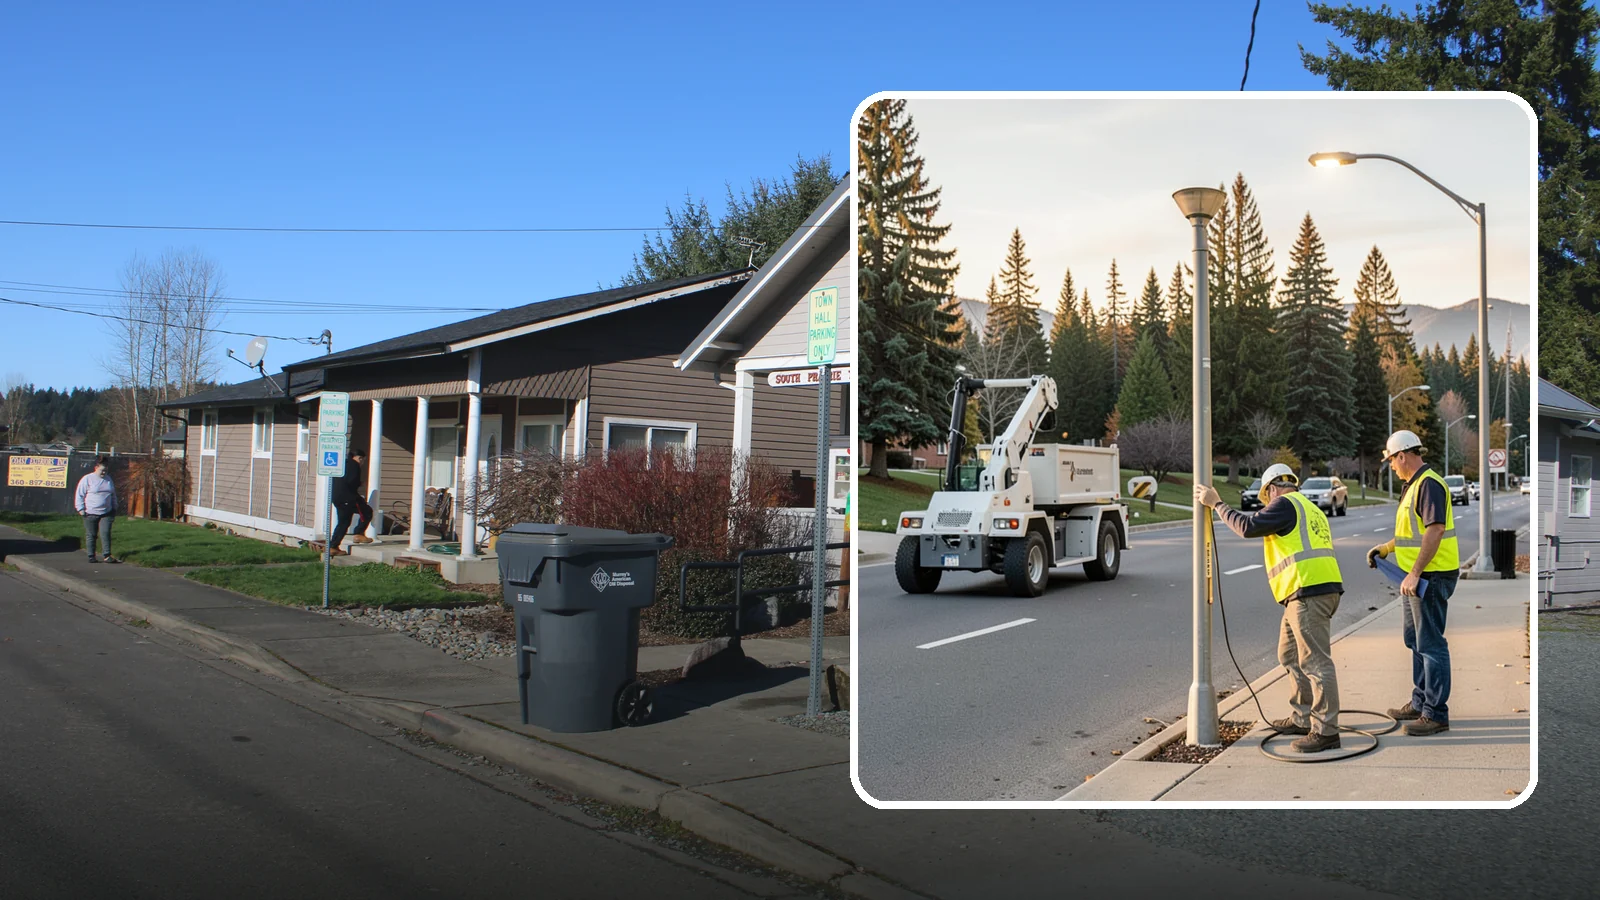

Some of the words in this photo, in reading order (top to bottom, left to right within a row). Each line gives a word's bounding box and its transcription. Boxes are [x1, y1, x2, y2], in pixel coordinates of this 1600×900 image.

[815, 294, 833, 308] TOWN
[814, 312, 831, 324] HALL
[810, 326, 836, 341] PARKING
[814, 344, 831, 357] ONLY
[775, 373, 801, 384] SOUTH
